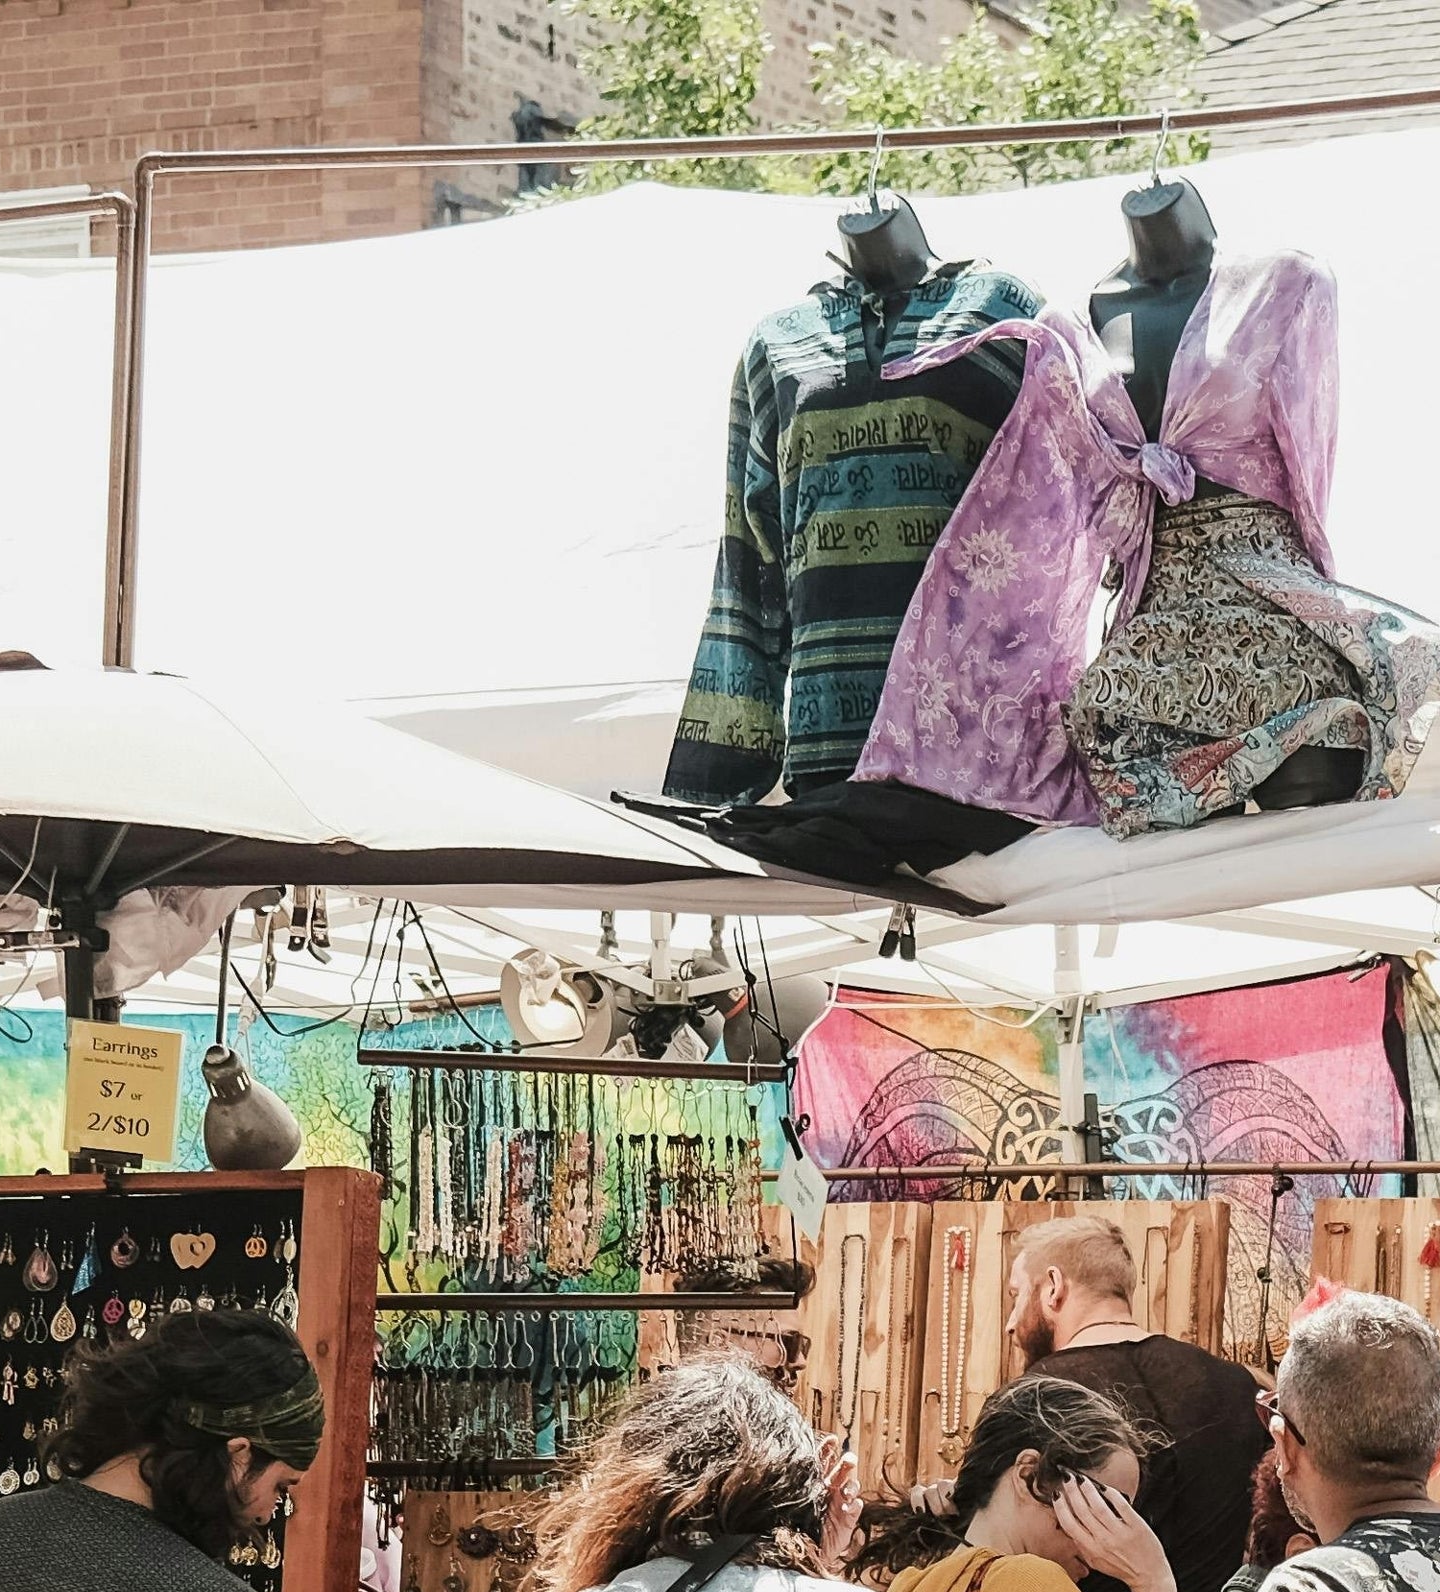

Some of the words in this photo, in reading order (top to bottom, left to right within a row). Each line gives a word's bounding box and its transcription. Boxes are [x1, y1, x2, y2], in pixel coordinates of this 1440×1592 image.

[92, 1036, 159, 1060] Earrings
[99, 1079, 127, 1098] $7
[130, 1092, 143, 1101] or
[87, 1111, 150, 1137] 2/$10
